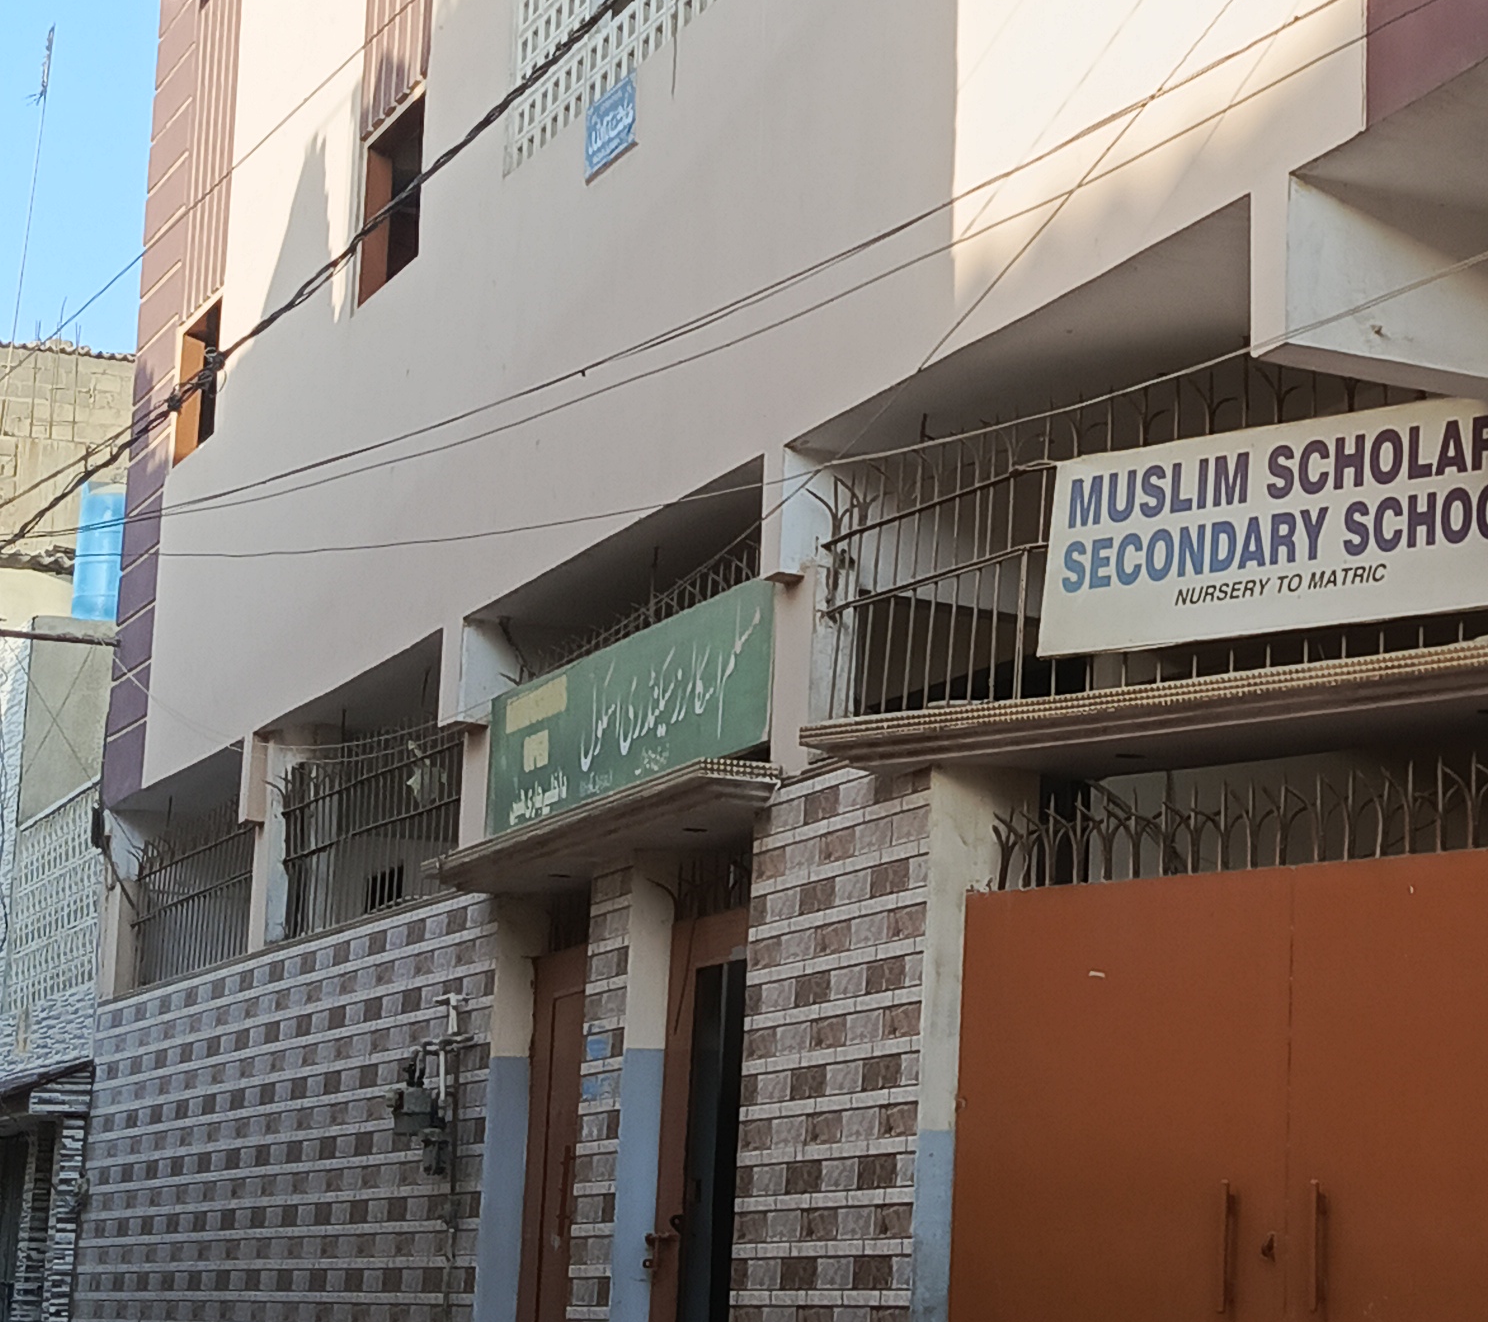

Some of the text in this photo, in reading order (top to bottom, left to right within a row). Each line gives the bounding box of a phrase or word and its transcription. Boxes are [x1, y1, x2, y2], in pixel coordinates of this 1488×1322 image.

[1068, 451, 1250, 530] MUSLIM
[1061, 506, 1329, 594] SECONDARY
[1174, 563, 1388, 607] NURSERY TO MATRIC
[718, 599, 761, 741] مسلم
